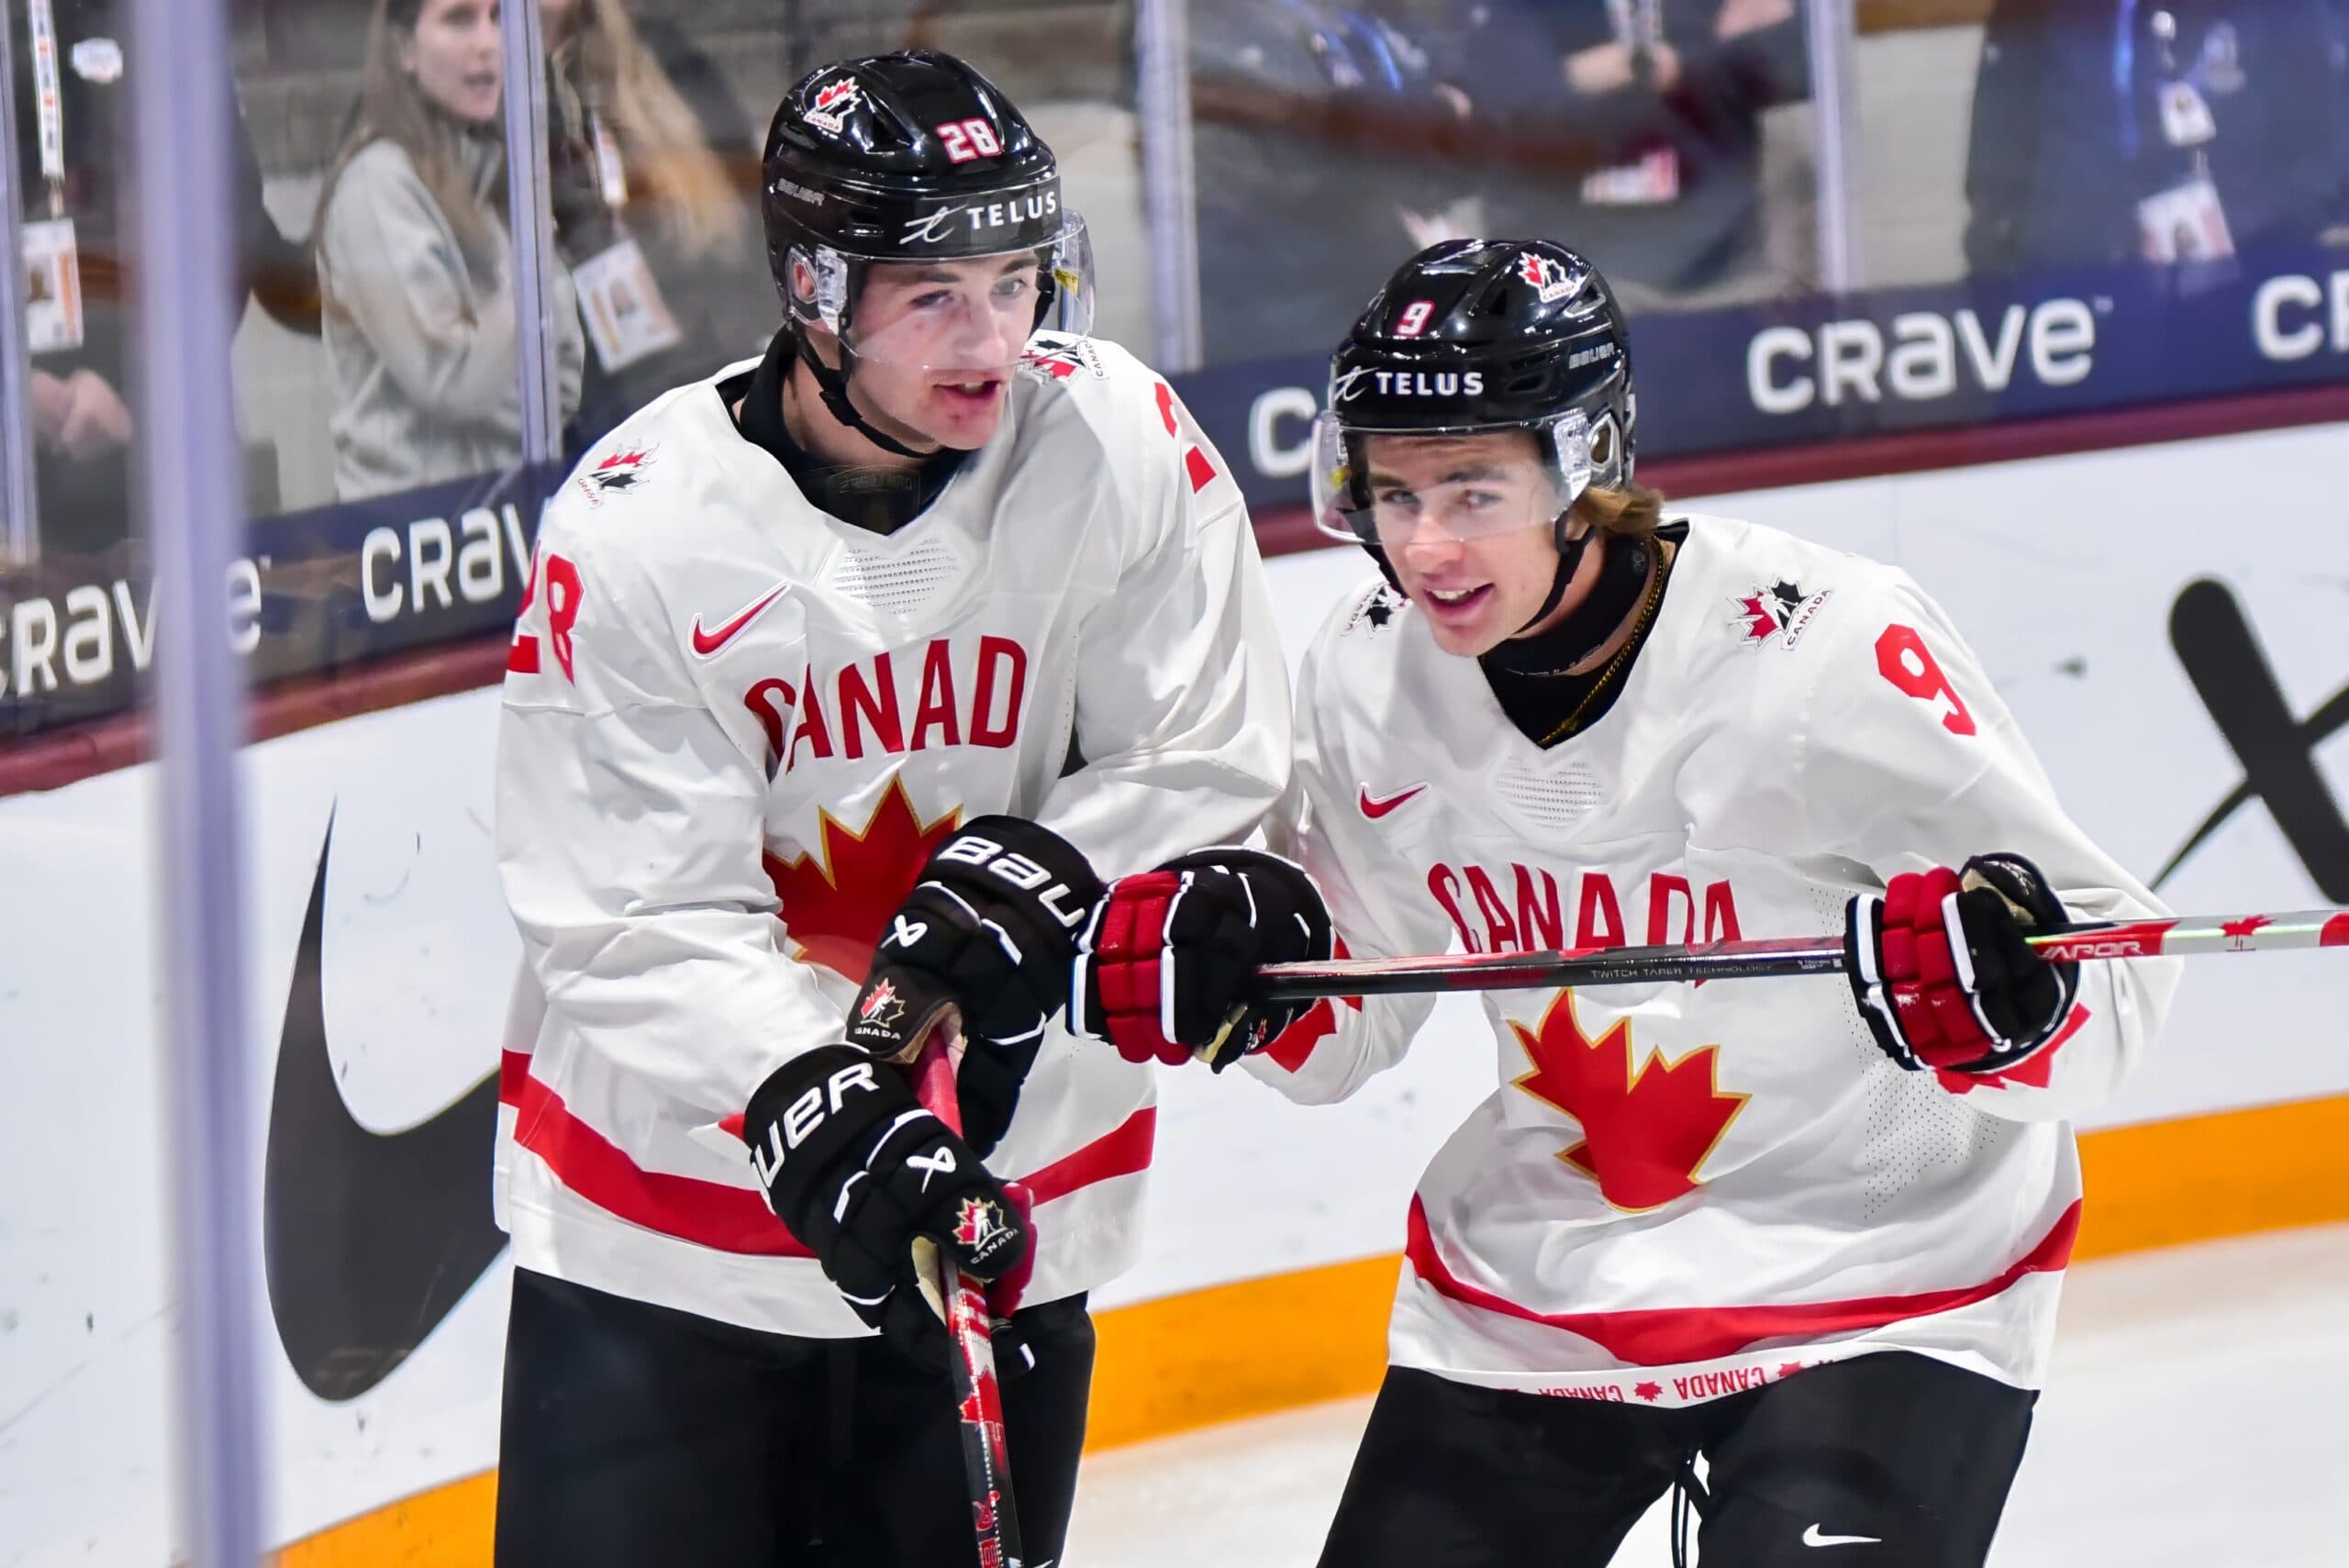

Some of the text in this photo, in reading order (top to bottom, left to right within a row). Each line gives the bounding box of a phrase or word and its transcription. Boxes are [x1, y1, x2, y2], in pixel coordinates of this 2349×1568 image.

[935, 117, 1002, 164] 28
[967, 191, 1057, 230] TELUS
[1395, 299, 1435, 338] 9
[1375, 371, 1485, 396] TELUS
[1787, 589, 1831, 646] CANADA
[1875, 623, 1976, 736] 9
[1672, 1366, 1768, 1401] CANADA
